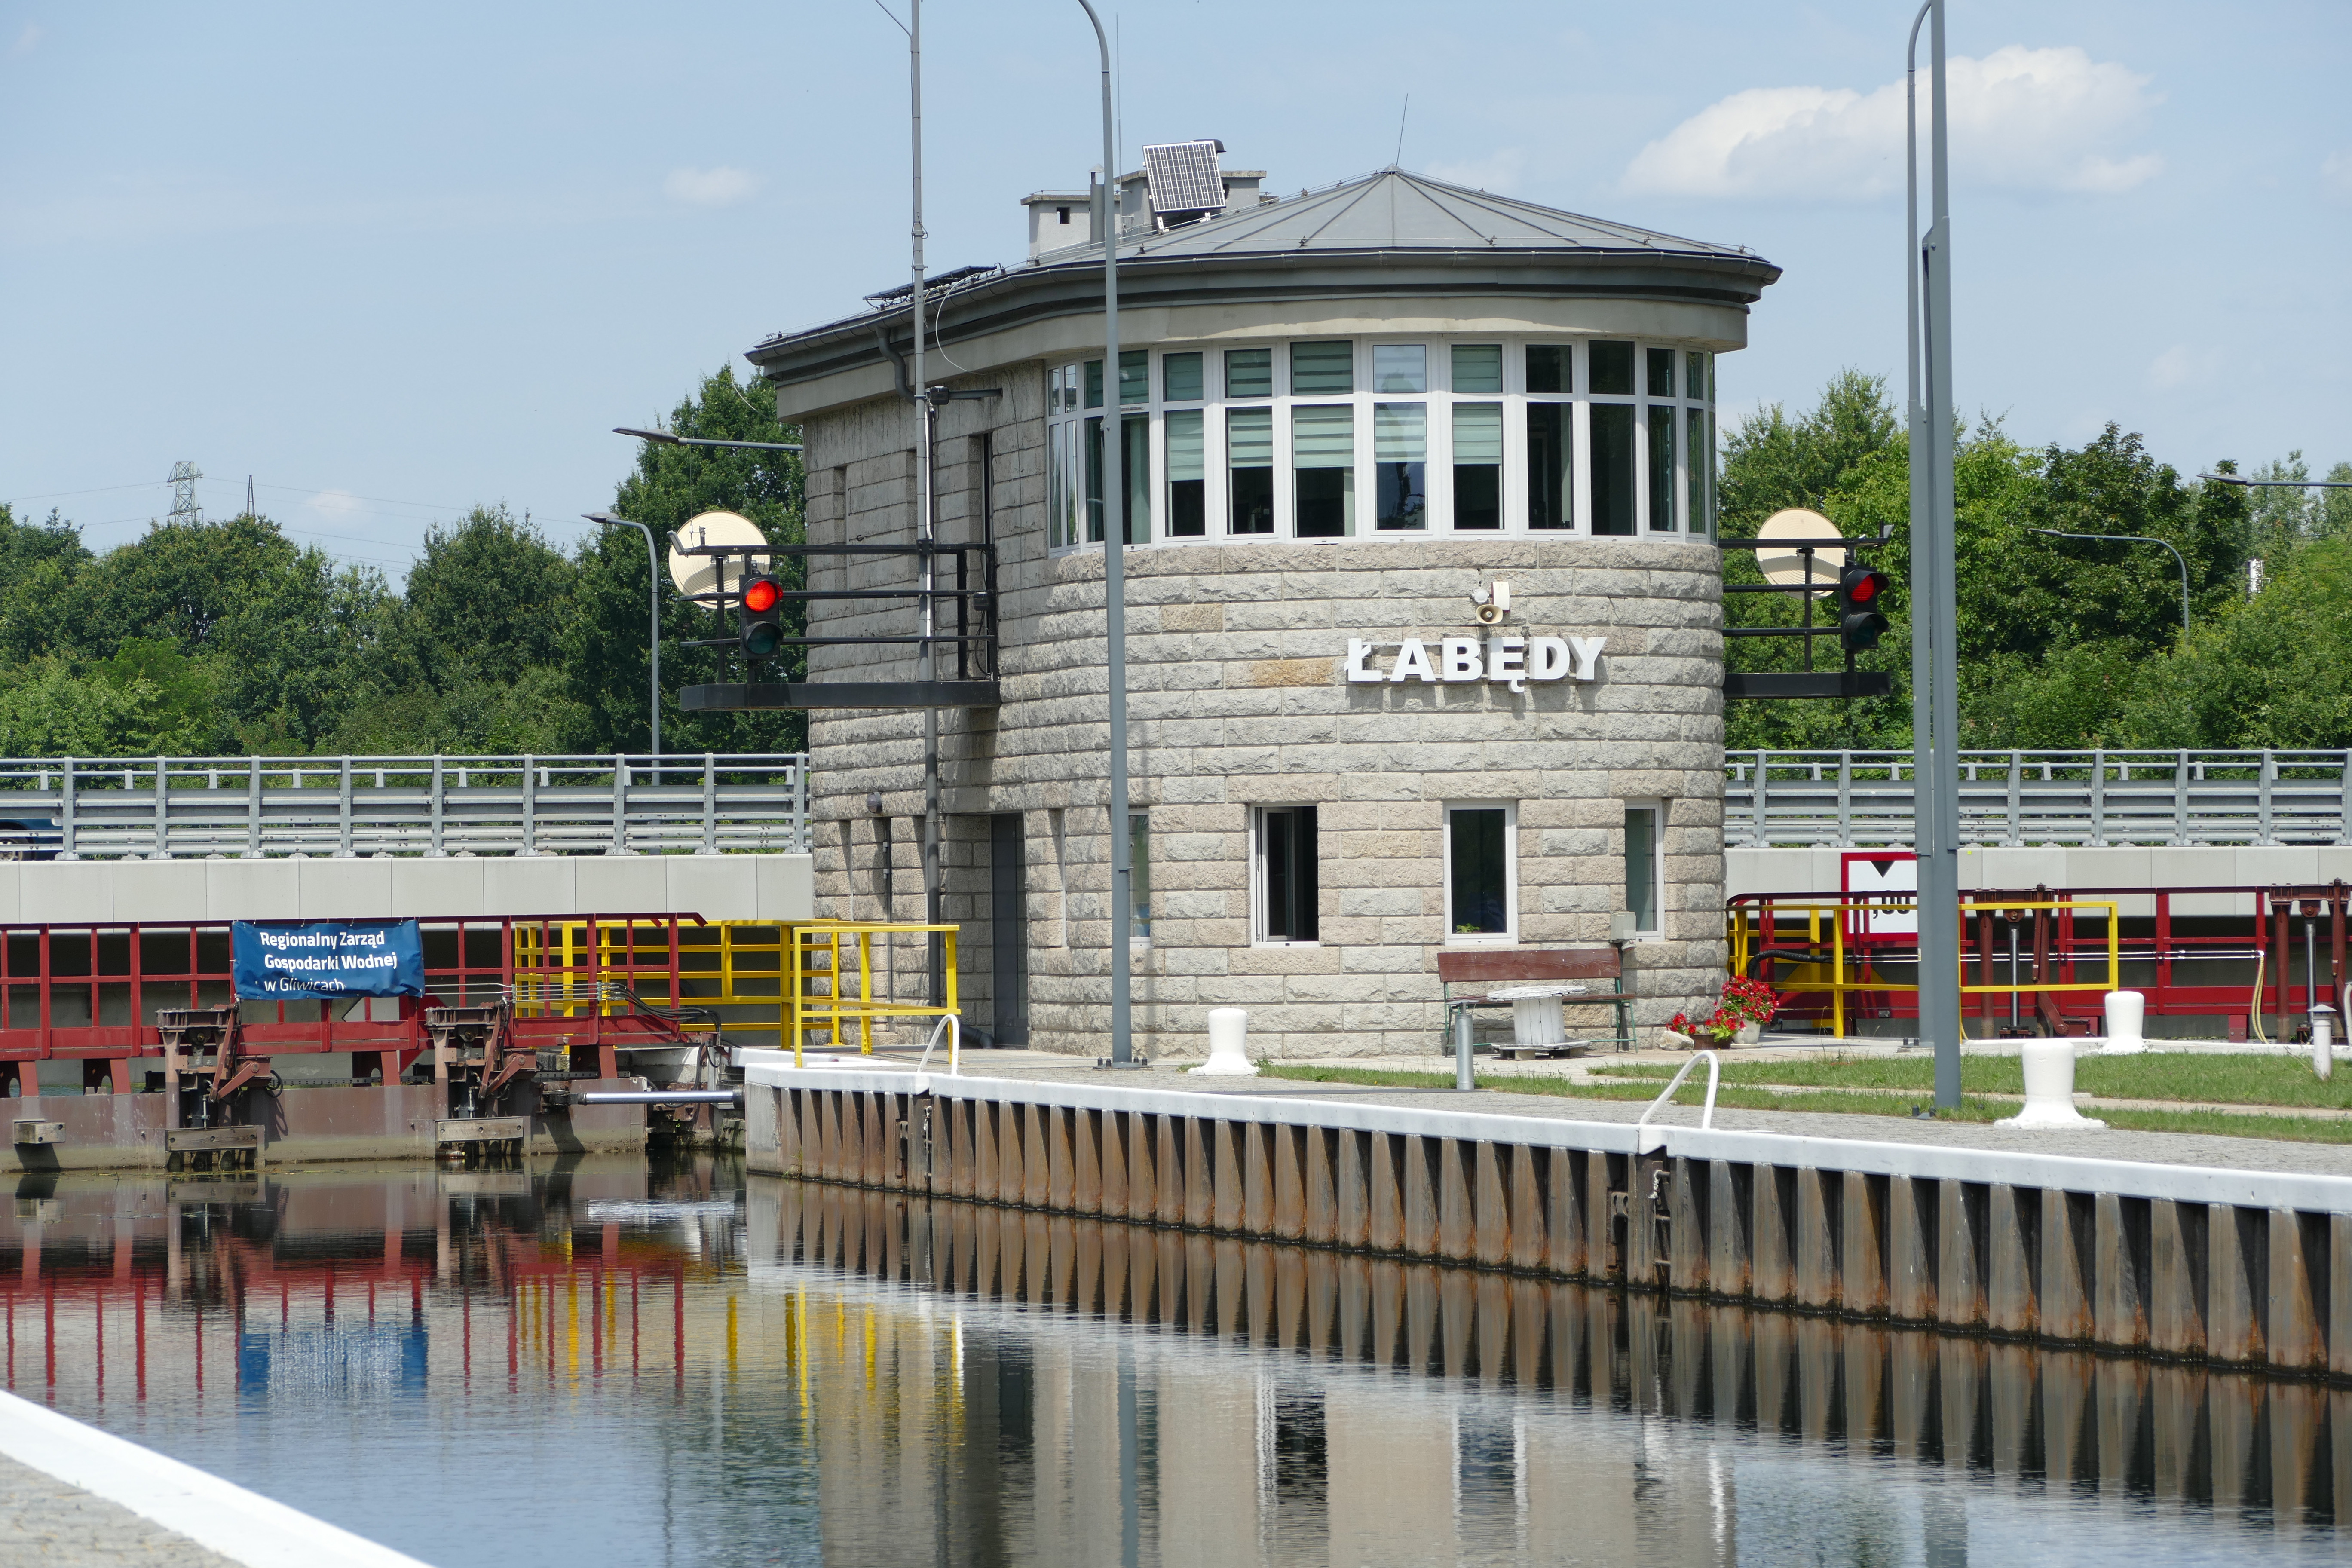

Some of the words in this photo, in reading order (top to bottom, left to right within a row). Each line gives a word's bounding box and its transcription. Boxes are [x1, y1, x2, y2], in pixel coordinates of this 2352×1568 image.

[1344, 637, 1607, 693] ŁABĘDY
[260, 932, 337, 950] Regionalny
[340, 931, 385, 949] Zarząd
[264, 954, 339, 973] Gospodarki
[341, 952, 397, 969] Wodnej
[264, 981, 276, 992] w
[280, 977, 344, 991] Gliwicach
